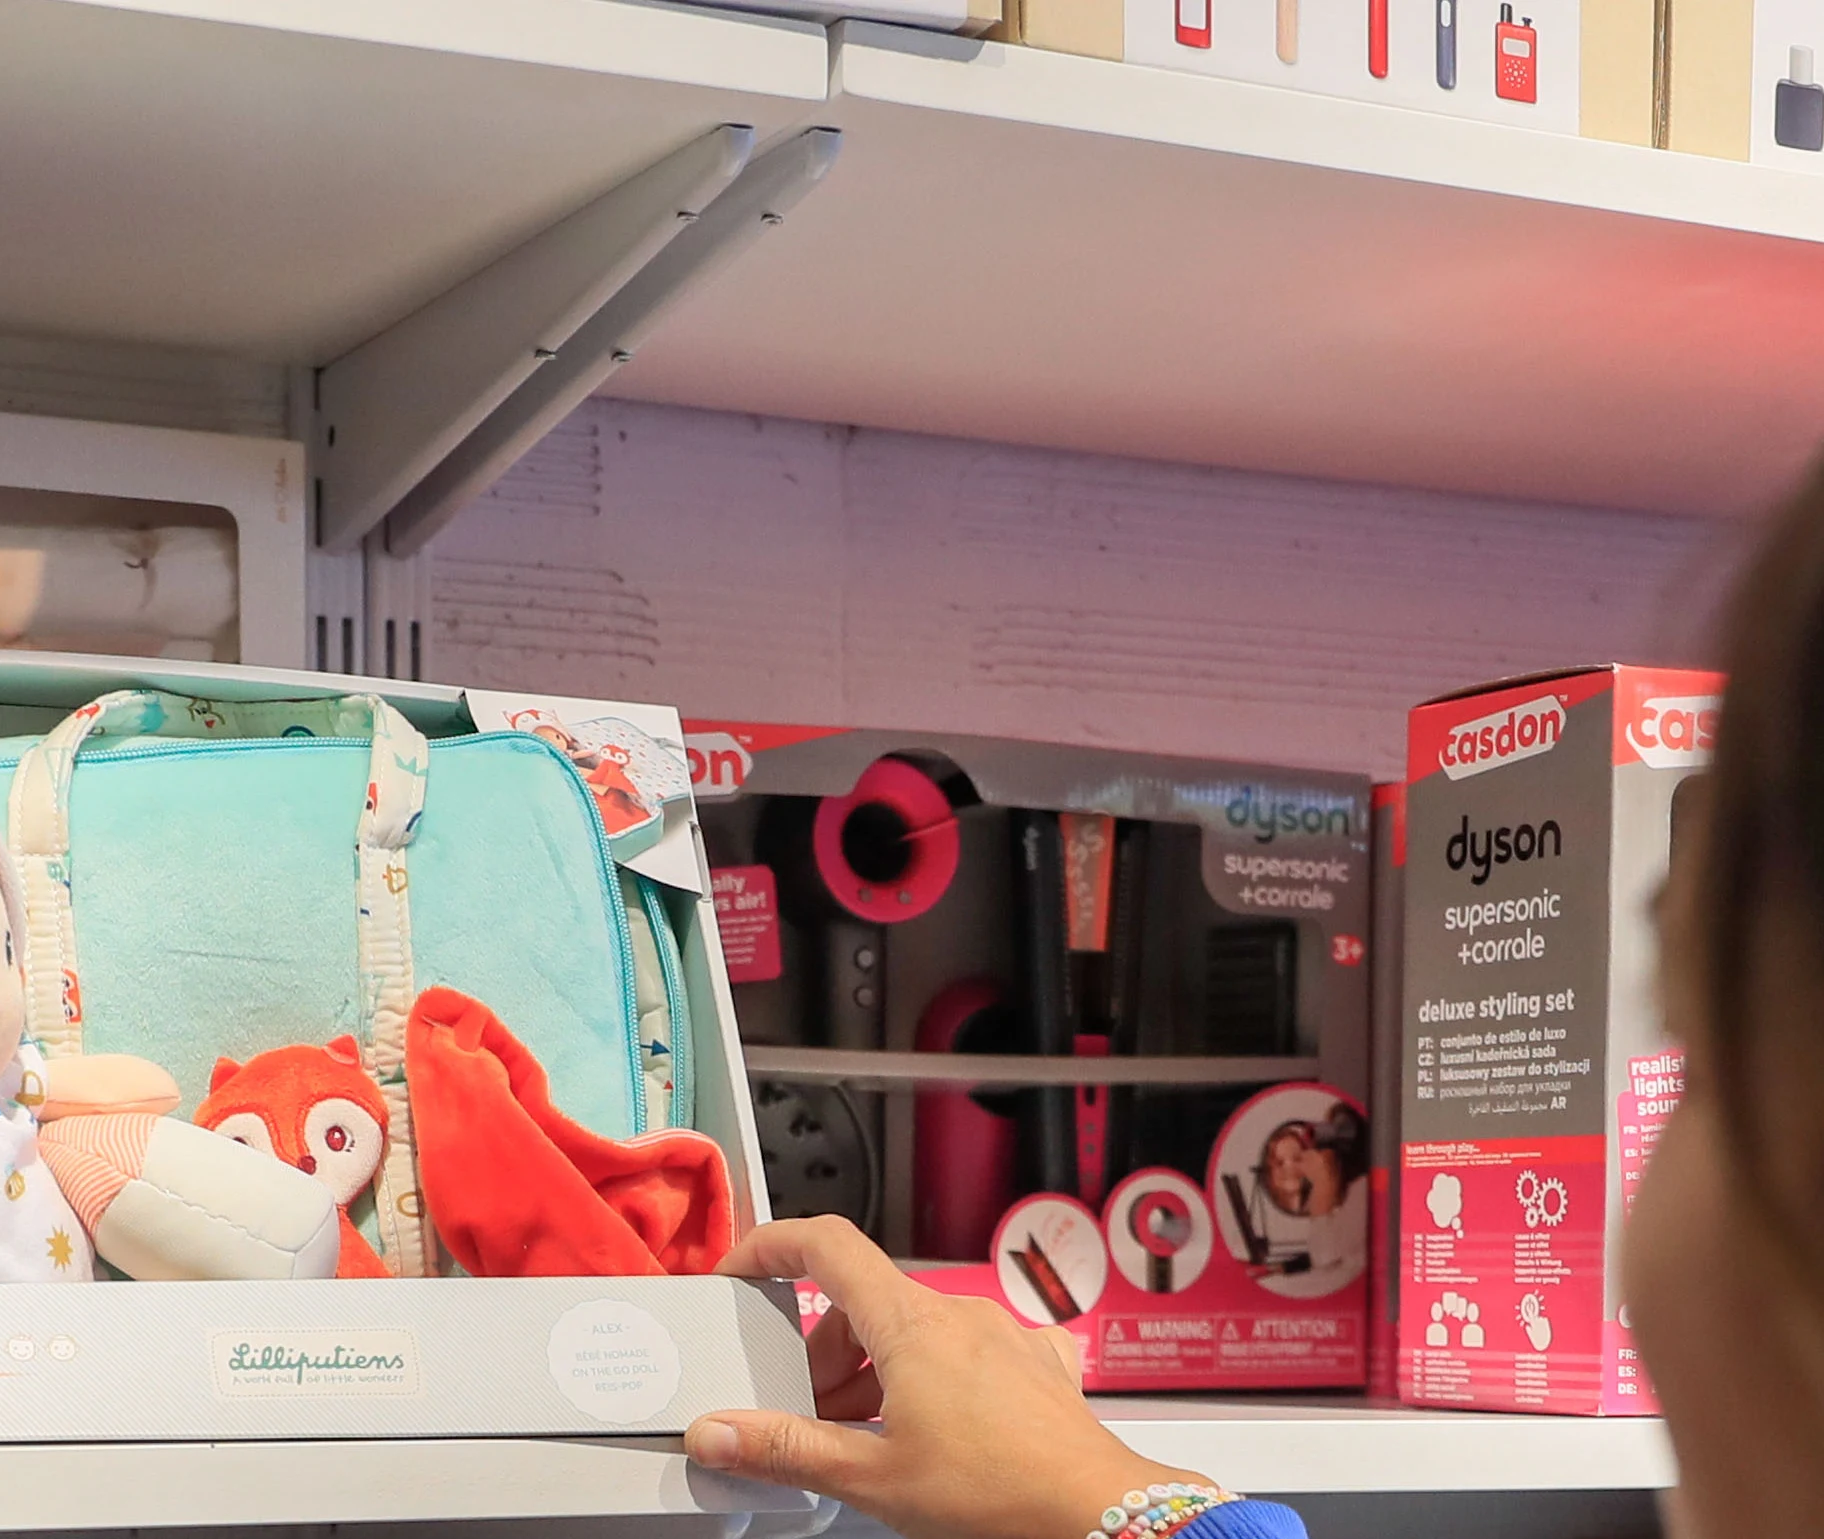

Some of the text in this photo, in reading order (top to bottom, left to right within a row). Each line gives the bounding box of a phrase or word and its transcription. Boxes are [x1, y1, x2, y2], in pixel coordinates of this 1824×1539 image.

[1441, 708, 1561, 767] casdon
[1631, 705, 1719, 751] cas
[1226, 786, 1351, 844] dyson
[1445, 814, 1562, 887] dyson
[1224, 854, 1350, 883] supersonic
[1444, 888, 1562, 936] supersonic
[1332, 935, 1363, 962] 3+
[1457, 926, 1546, 966] +corrale
[1418, 988, 1576, 1024] deluxe styling set
[1484, 1031, 1497, 1045] de
[1528, 1028, 1542, 1041] de
[1544, 1026, 1567, 1040] luxo
[1532, 1044, 1557, 1058] sada
[1528, 1061, 1541, 1076] do
[1630, 1054, 1686, 1076] realist
[1633, 1075, 1686, 1098] lights
[1550, 1096, 1567, 1110] AR
[592, 1322, 624, 1335] ALEX
[228, 1342, 405, 1385] Lilliputiens
[1617, 1348, 1638, 1360] FR:
[1617, 1365, 1637, 1378] ES:
[1617, 1382, 1638, 1395] DE:
